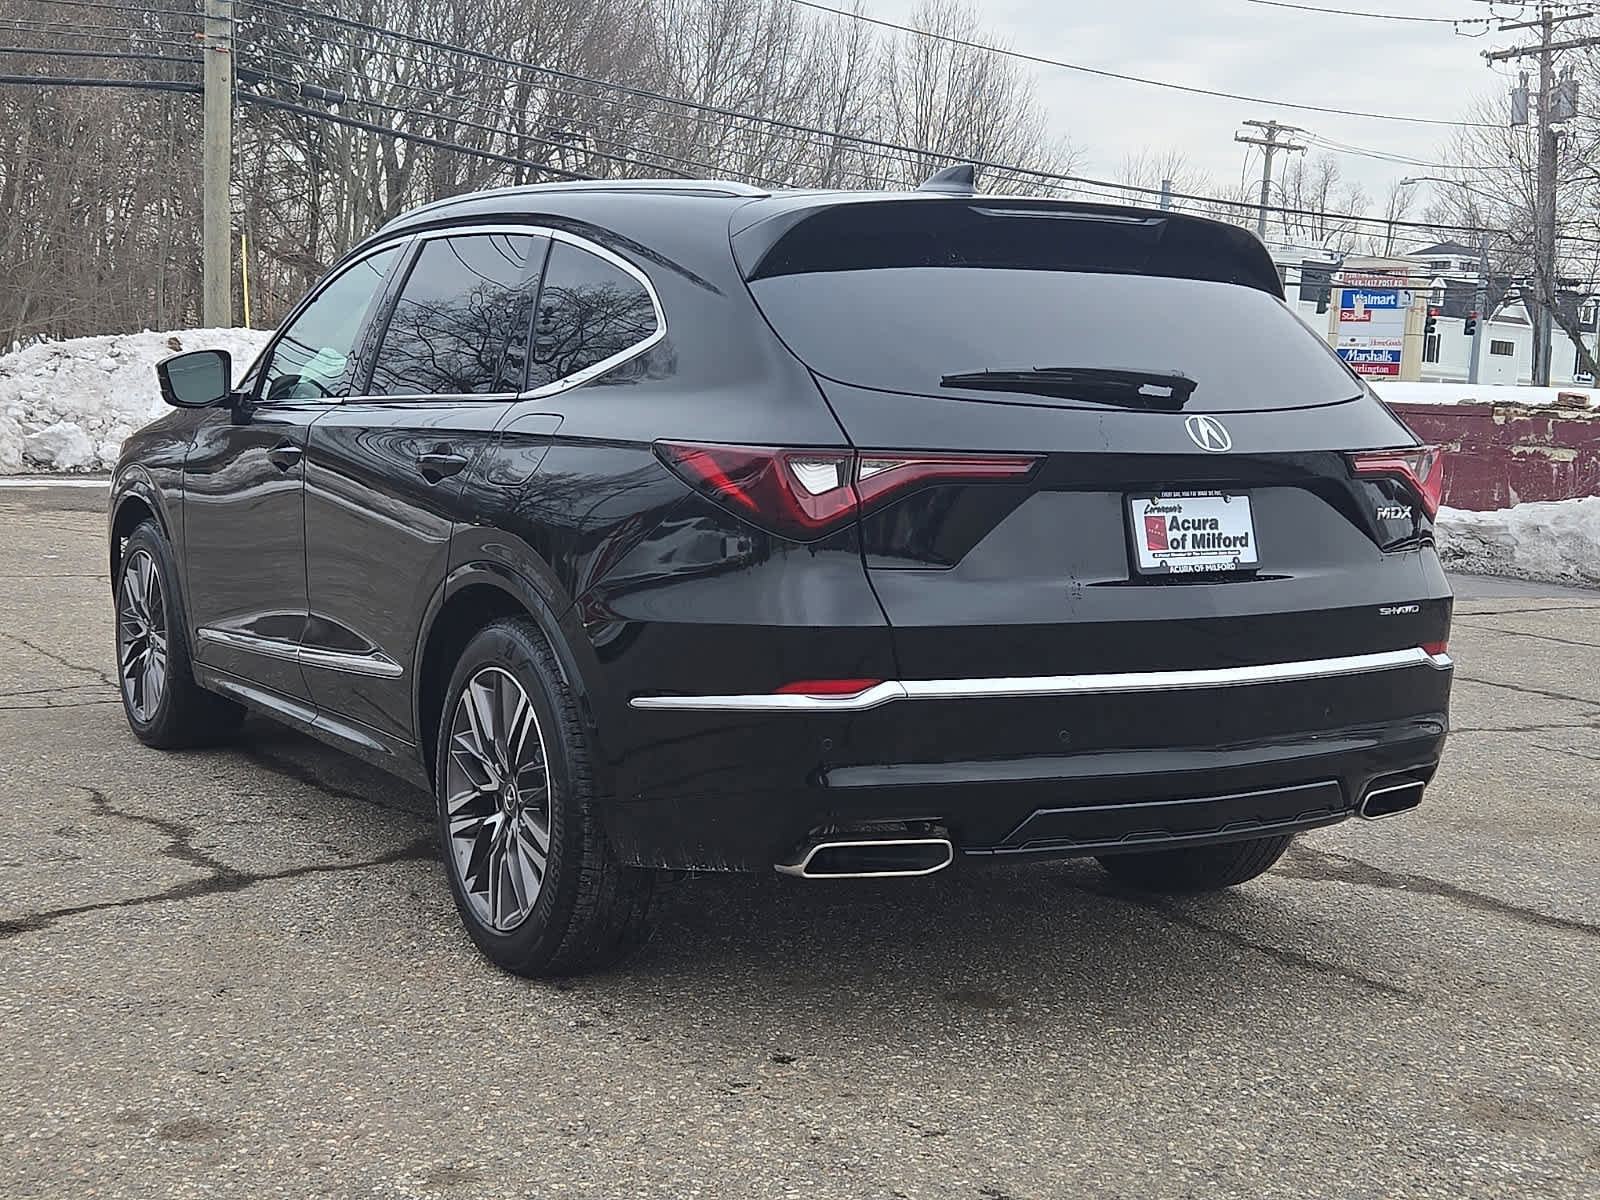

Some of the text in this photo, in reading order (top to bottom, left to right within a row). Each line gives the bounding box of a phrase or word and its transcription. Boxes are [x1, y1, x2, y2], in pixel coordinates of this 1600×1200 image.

[1353, 294, 1396, 305] Walmart
[1343, 349, 1393, 361] Marshalls
[1353, 364, 1389, 375] urlington
[1376, 505, 1412, 520] MDX
[1168, 516, 1219, 531] Acura
[1170, 532, 1249, 550] of Milford
[1169, 563, 1236, 574] ACURA OF MILFORD
